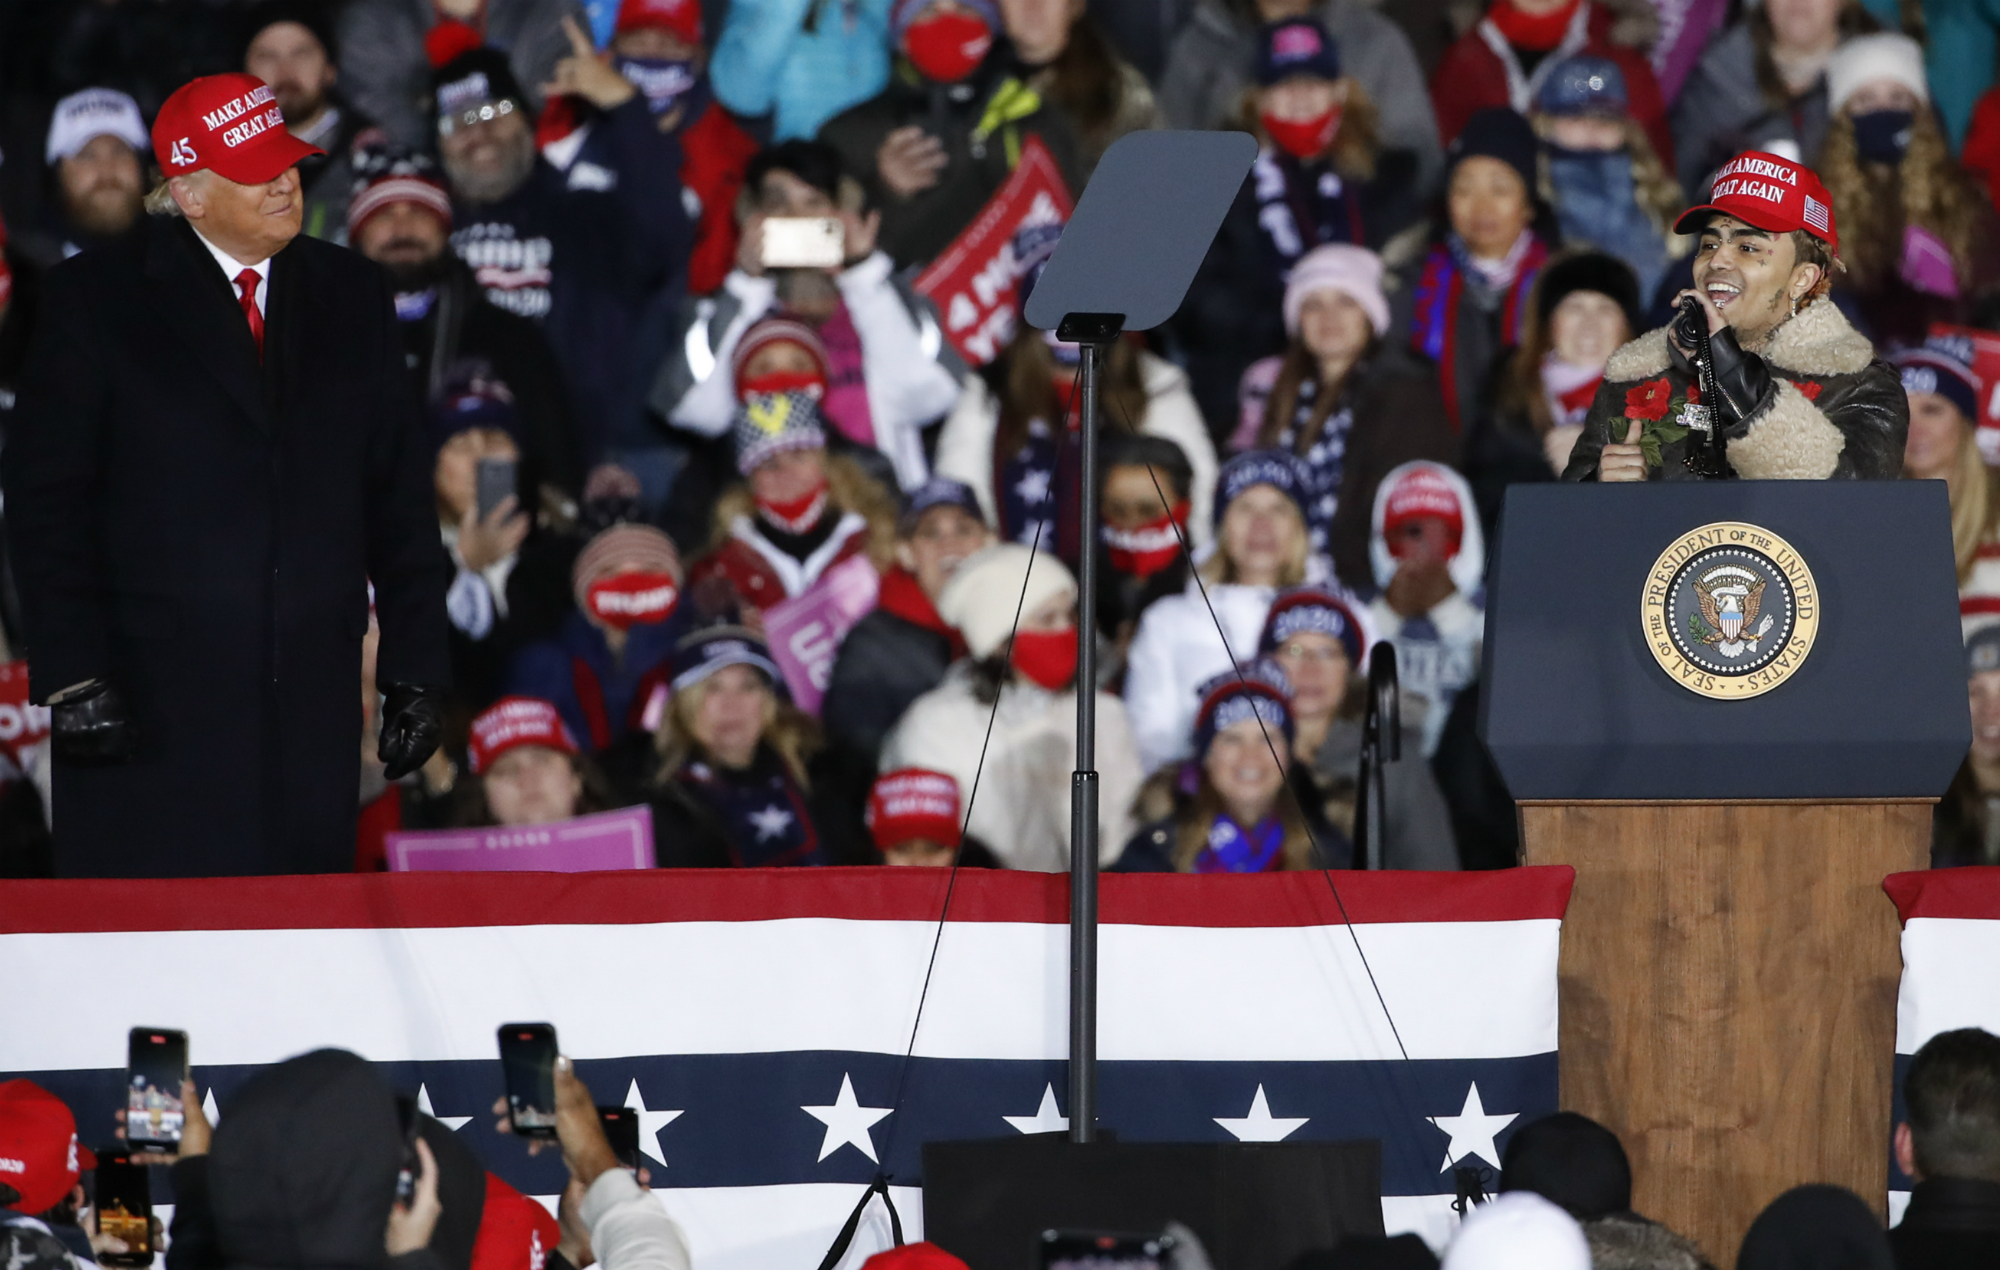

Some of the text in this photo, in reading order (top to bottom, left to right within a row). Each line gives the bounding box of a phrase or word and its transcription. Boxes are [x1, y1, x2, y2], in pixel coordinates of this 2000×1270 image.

[202, 98, 246, 131] MAKE
[223, 115, 267, 148] GREAT
[171, 137, 197, 167] 45
[1734, 158, 1798, 186] AMERICA
[1710, 179, 1785, 205] REAT AGAIN
[1648, 528, 1813, 691] SEAL OF THE PRESIDENT OF THE UNITED STATES
